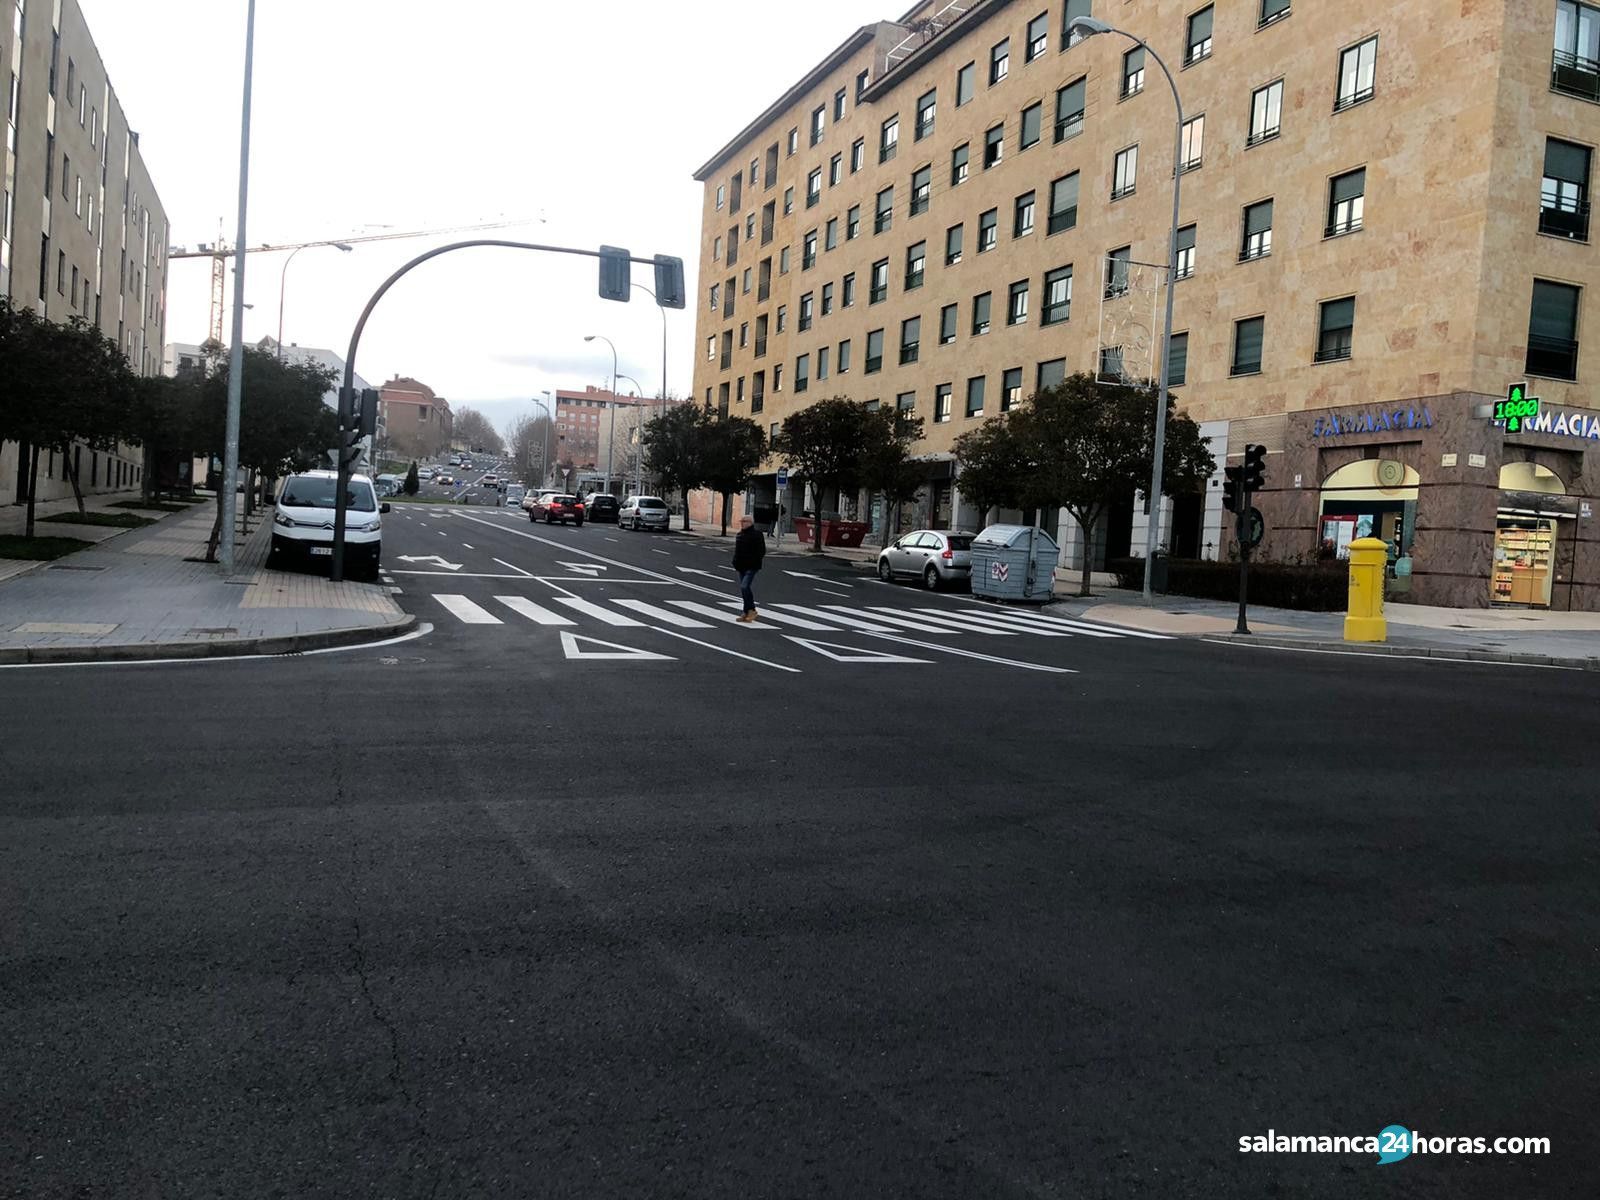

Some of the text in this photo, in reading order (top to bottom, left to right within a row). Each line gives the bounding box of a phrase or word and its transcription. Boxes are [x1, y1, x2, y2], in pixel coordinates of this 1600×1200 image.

[1313, 406, 1432, 437] FARMACIA
[1495, 400, 1538, 418] 18:00
[1490, 410, 1600, 439] MACIA
